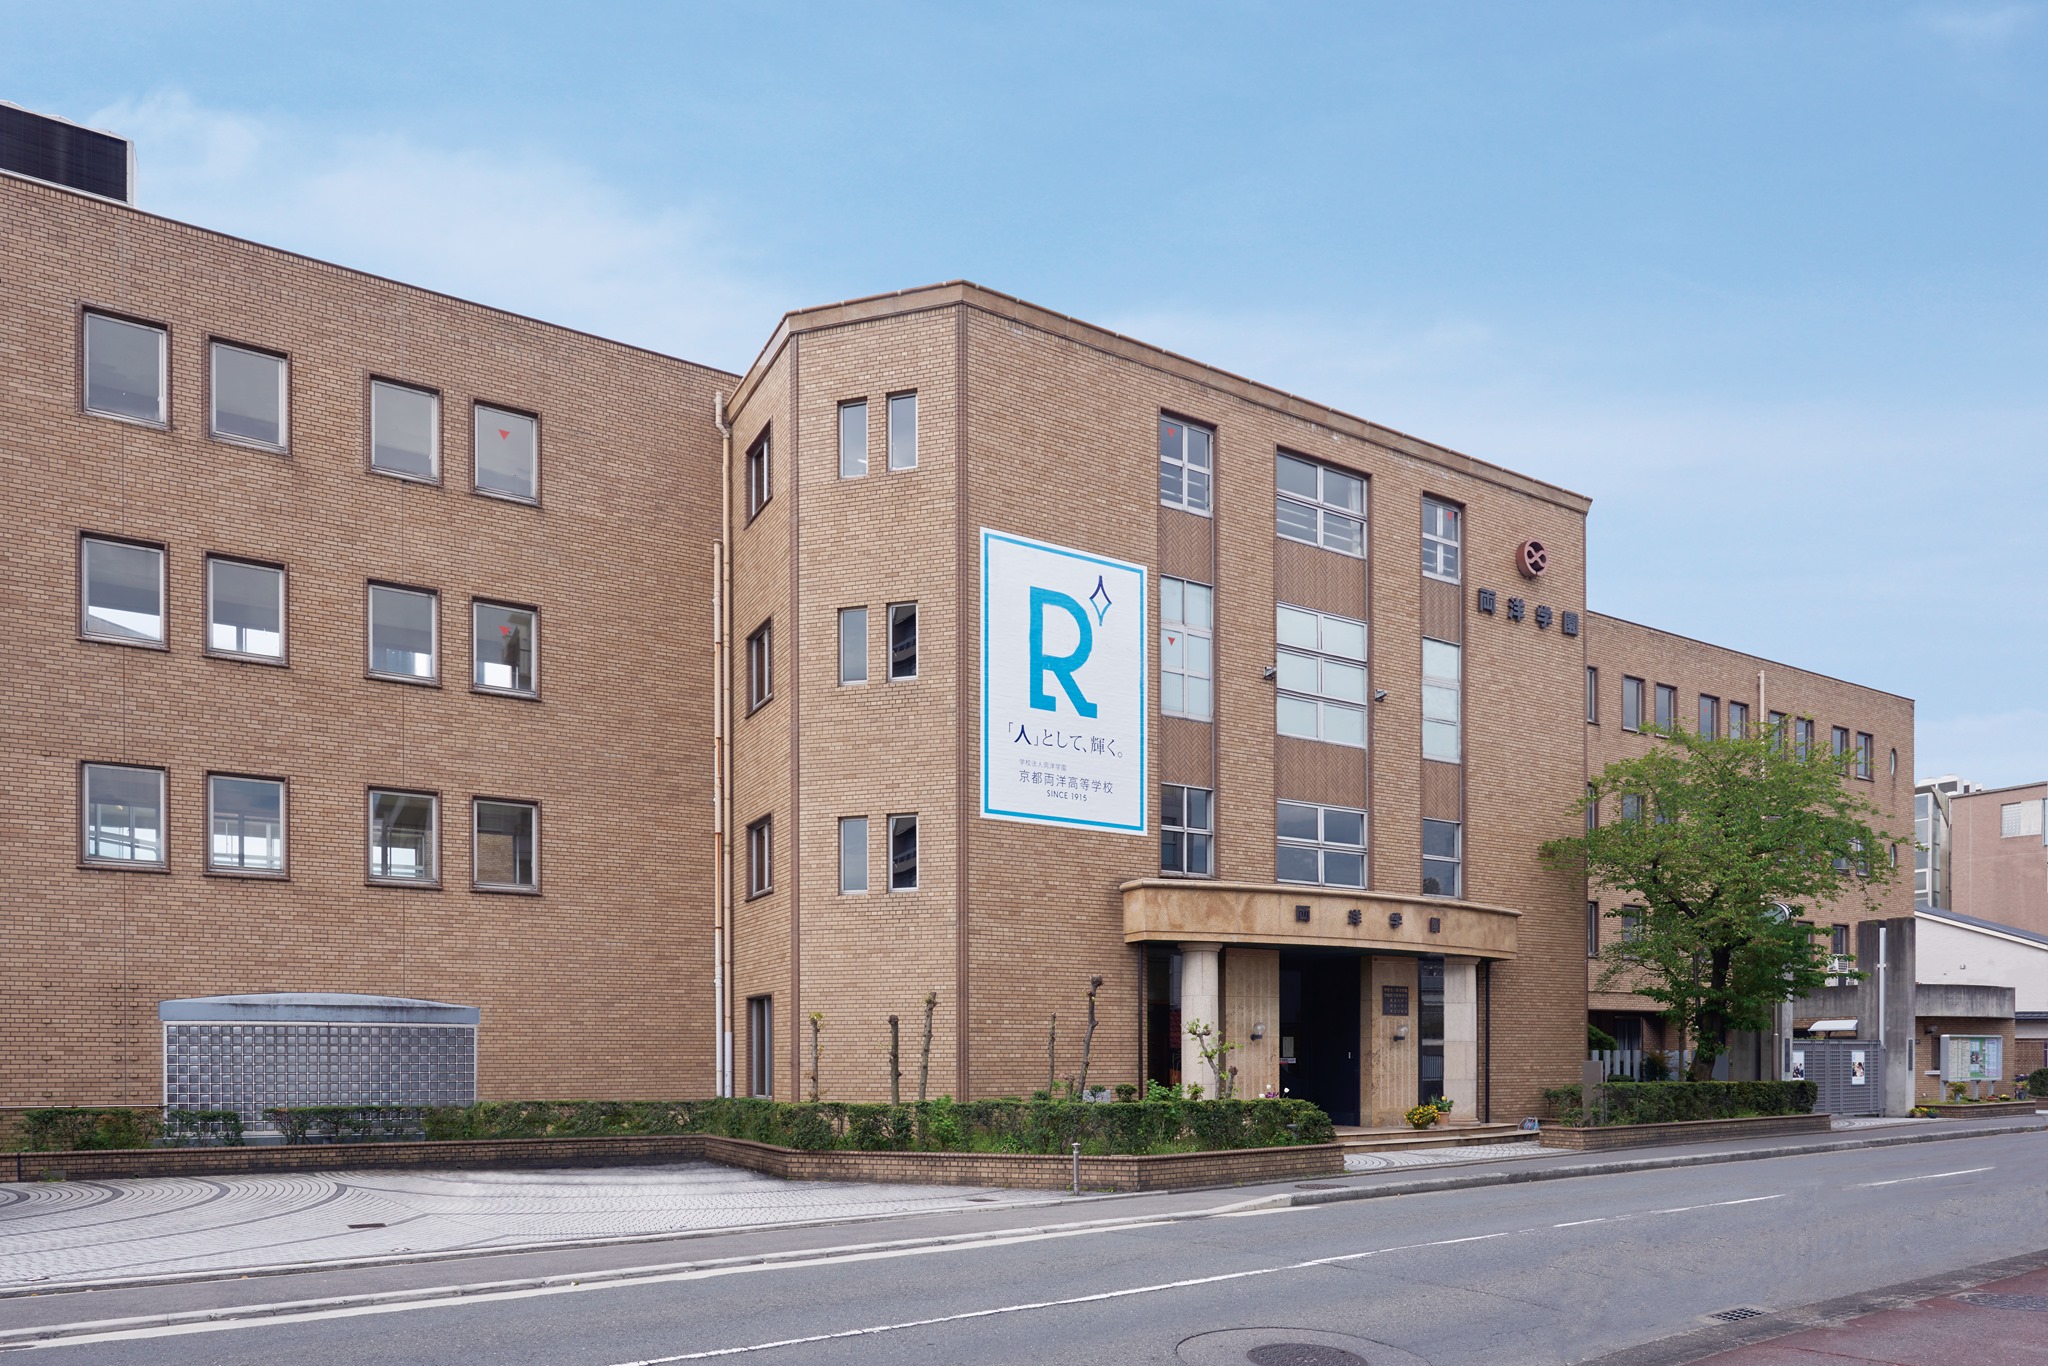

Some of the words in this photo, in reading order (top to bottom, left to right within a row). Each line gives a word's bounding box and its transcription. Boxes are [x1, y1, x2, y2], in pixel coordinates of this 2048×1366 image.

[1029, 586, 1098, 719] R
[1019, 769, 1114, 794] 京都両洋高等学校
[1047, 789, 1068, 800] SINCE
[1071, 792, 1088, 802] 1915
